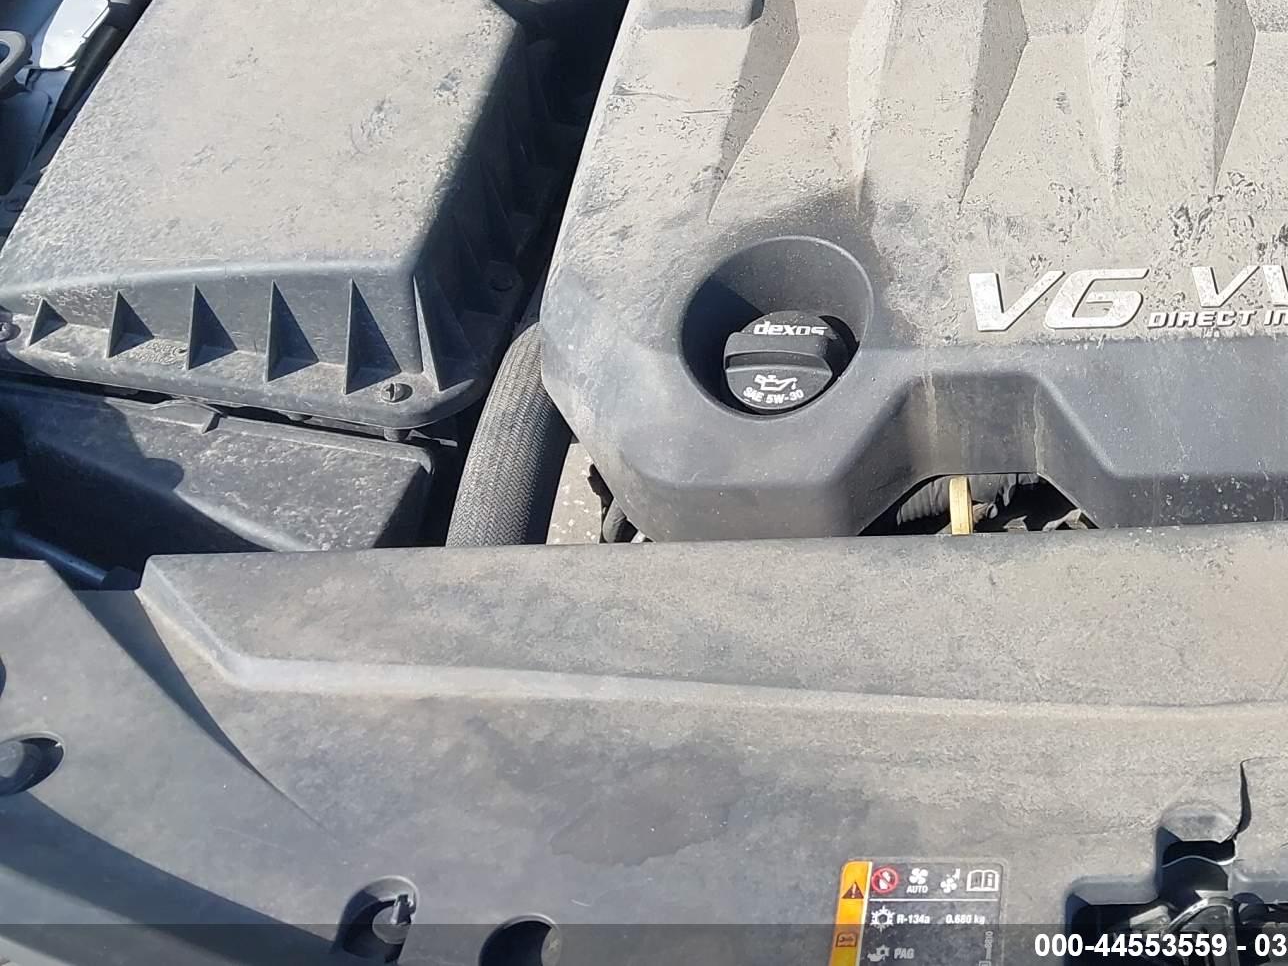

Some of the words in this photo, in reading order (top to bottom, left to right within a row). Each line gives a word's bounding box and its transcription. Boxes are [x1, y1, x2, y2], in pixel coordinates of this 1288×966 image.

[968, 267, 1149, 332] V6
[1147, 310, 1257, 330] DIRECT
[753, 321, 828, 336] dexos
[743, 387, 764, 403] SAE
[766, 389, 804, 404] 5W-30
[906, 885, 929, 894] AUTO
[896, 914, 931, 924] R-134a
[973, 914, 986, 925] kg
[893, 947, 915, 960] PAG
